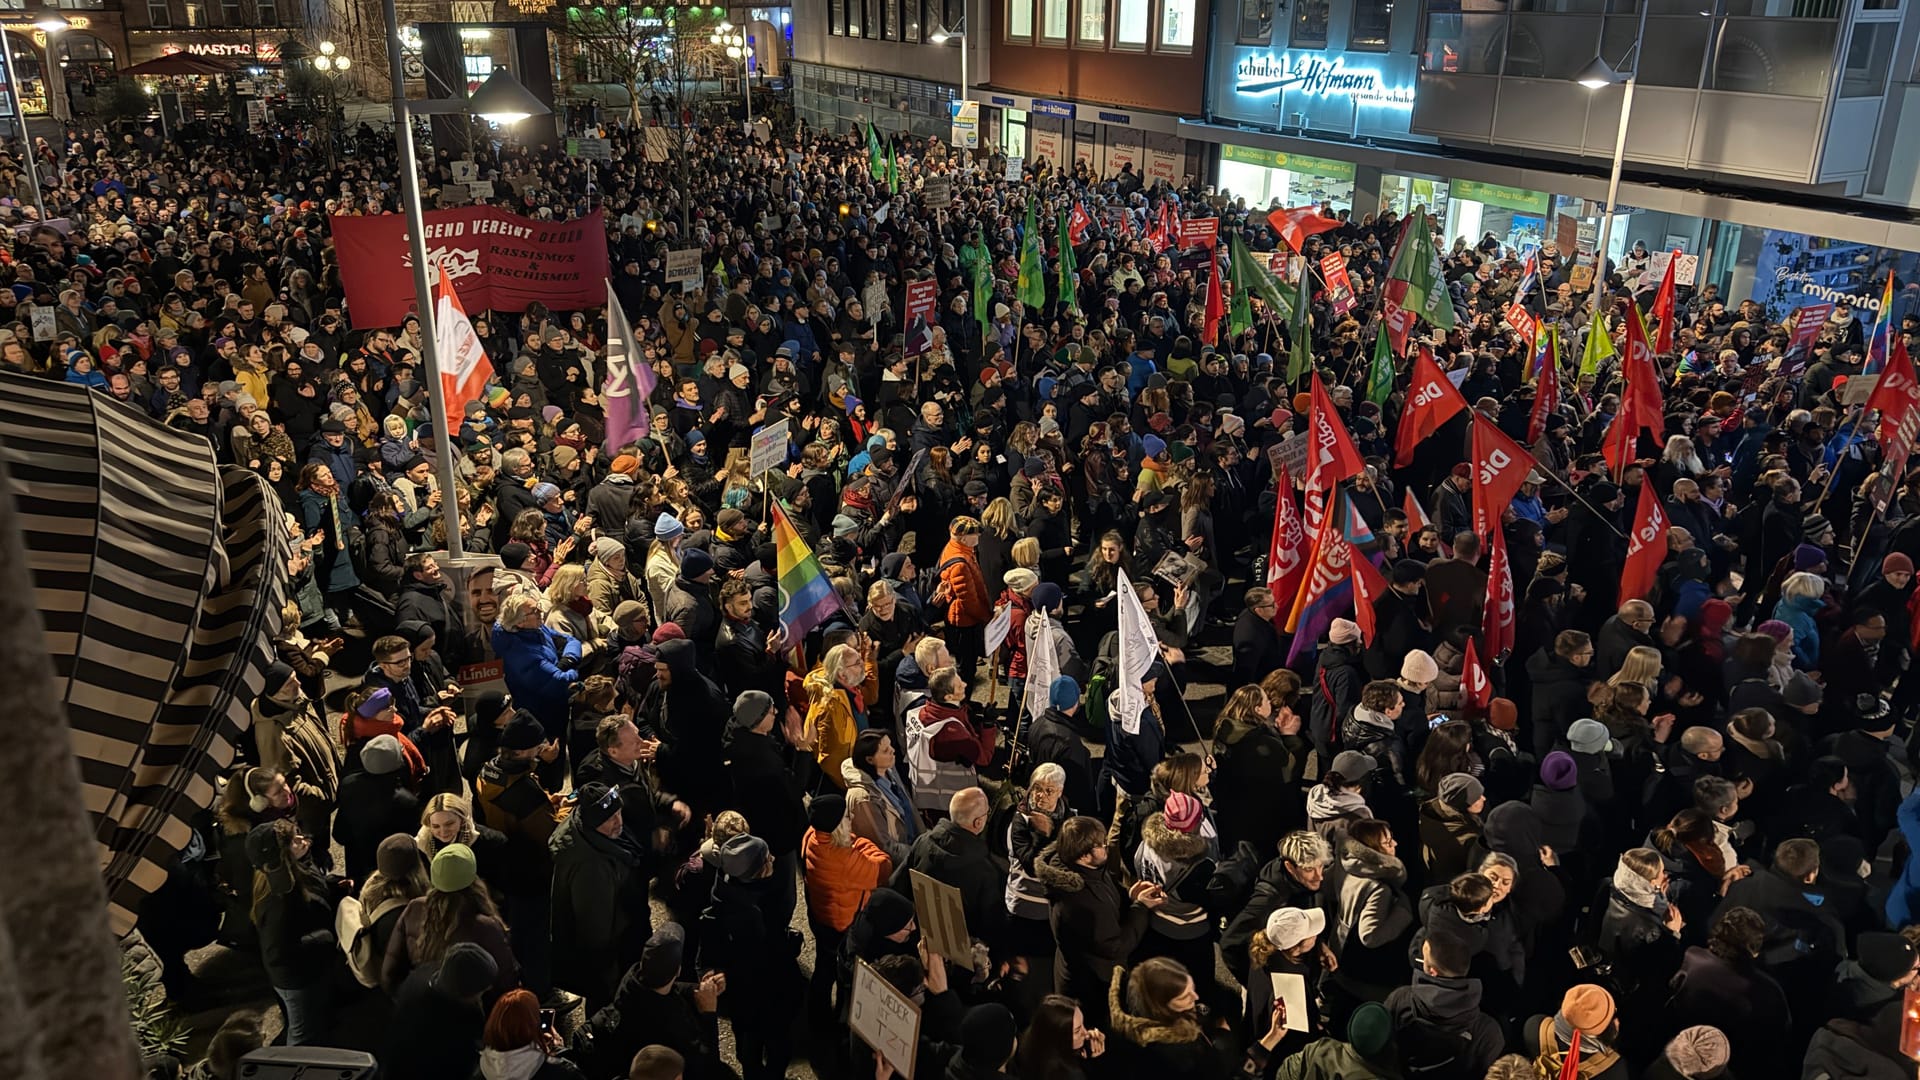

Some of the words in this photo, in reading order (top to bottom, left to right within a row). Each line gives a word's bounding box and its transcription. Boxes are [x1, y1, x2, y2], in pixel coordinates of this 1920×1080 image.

[188, 43, 252, 56] MAESTRO
[1237, 56, 1285, 79] schübel
[1294, 60, 1305, 80] &
[472, 219, 534, 240] VEREINT
[489, 245, 577, 263] RASSISMUS
[485, 264, 581, 282] FASCHISMUS
[1802, 283, 1882, 311] mymoria
[463, 667, 499, 681] Linke
